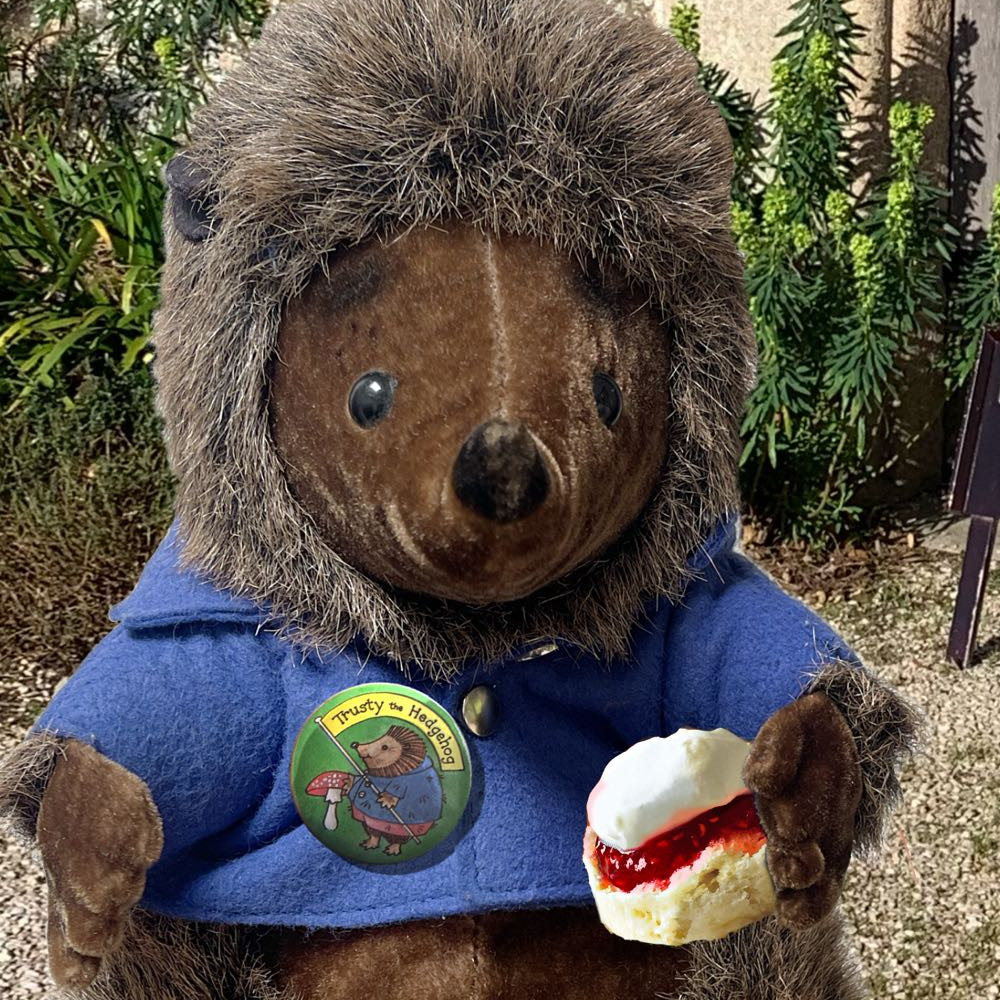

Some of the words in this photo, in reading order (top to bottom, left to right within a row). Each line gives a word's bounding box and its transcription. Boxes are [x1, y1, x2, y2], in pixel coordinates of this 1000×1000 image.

[331, 698, 385, 725] Trusty
[388, 702, 404, 712] the
[409, 704, 455, 765] Hedgehog
